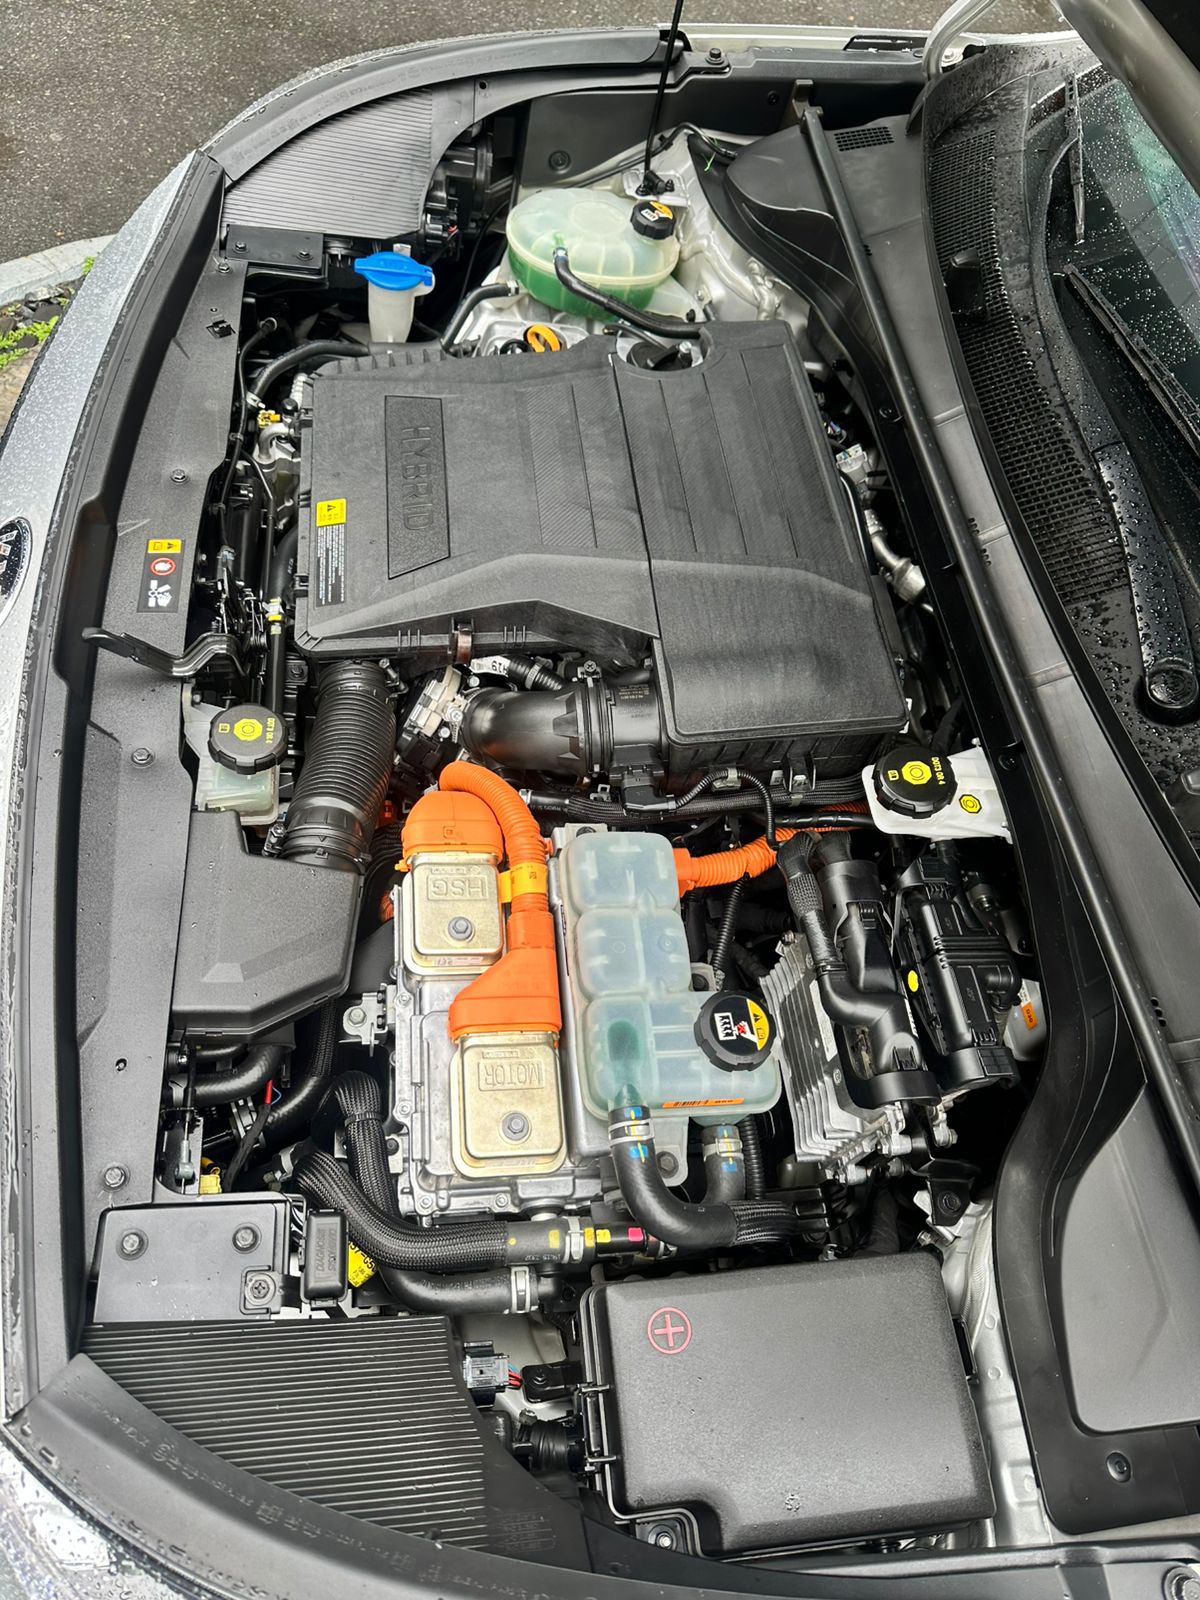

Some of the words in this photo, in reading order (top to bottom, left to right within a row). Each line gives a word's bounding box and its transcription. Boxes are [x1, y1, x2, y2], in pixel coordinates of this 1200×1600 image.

[402, 427, 435, 531] HYBRID
[931, 756, 942, 771] DOT3
[935, 771, 945, 780] OR
[432, 877, 486, 898] HSG
[484, 1062, 541, 1086] MOTOR
